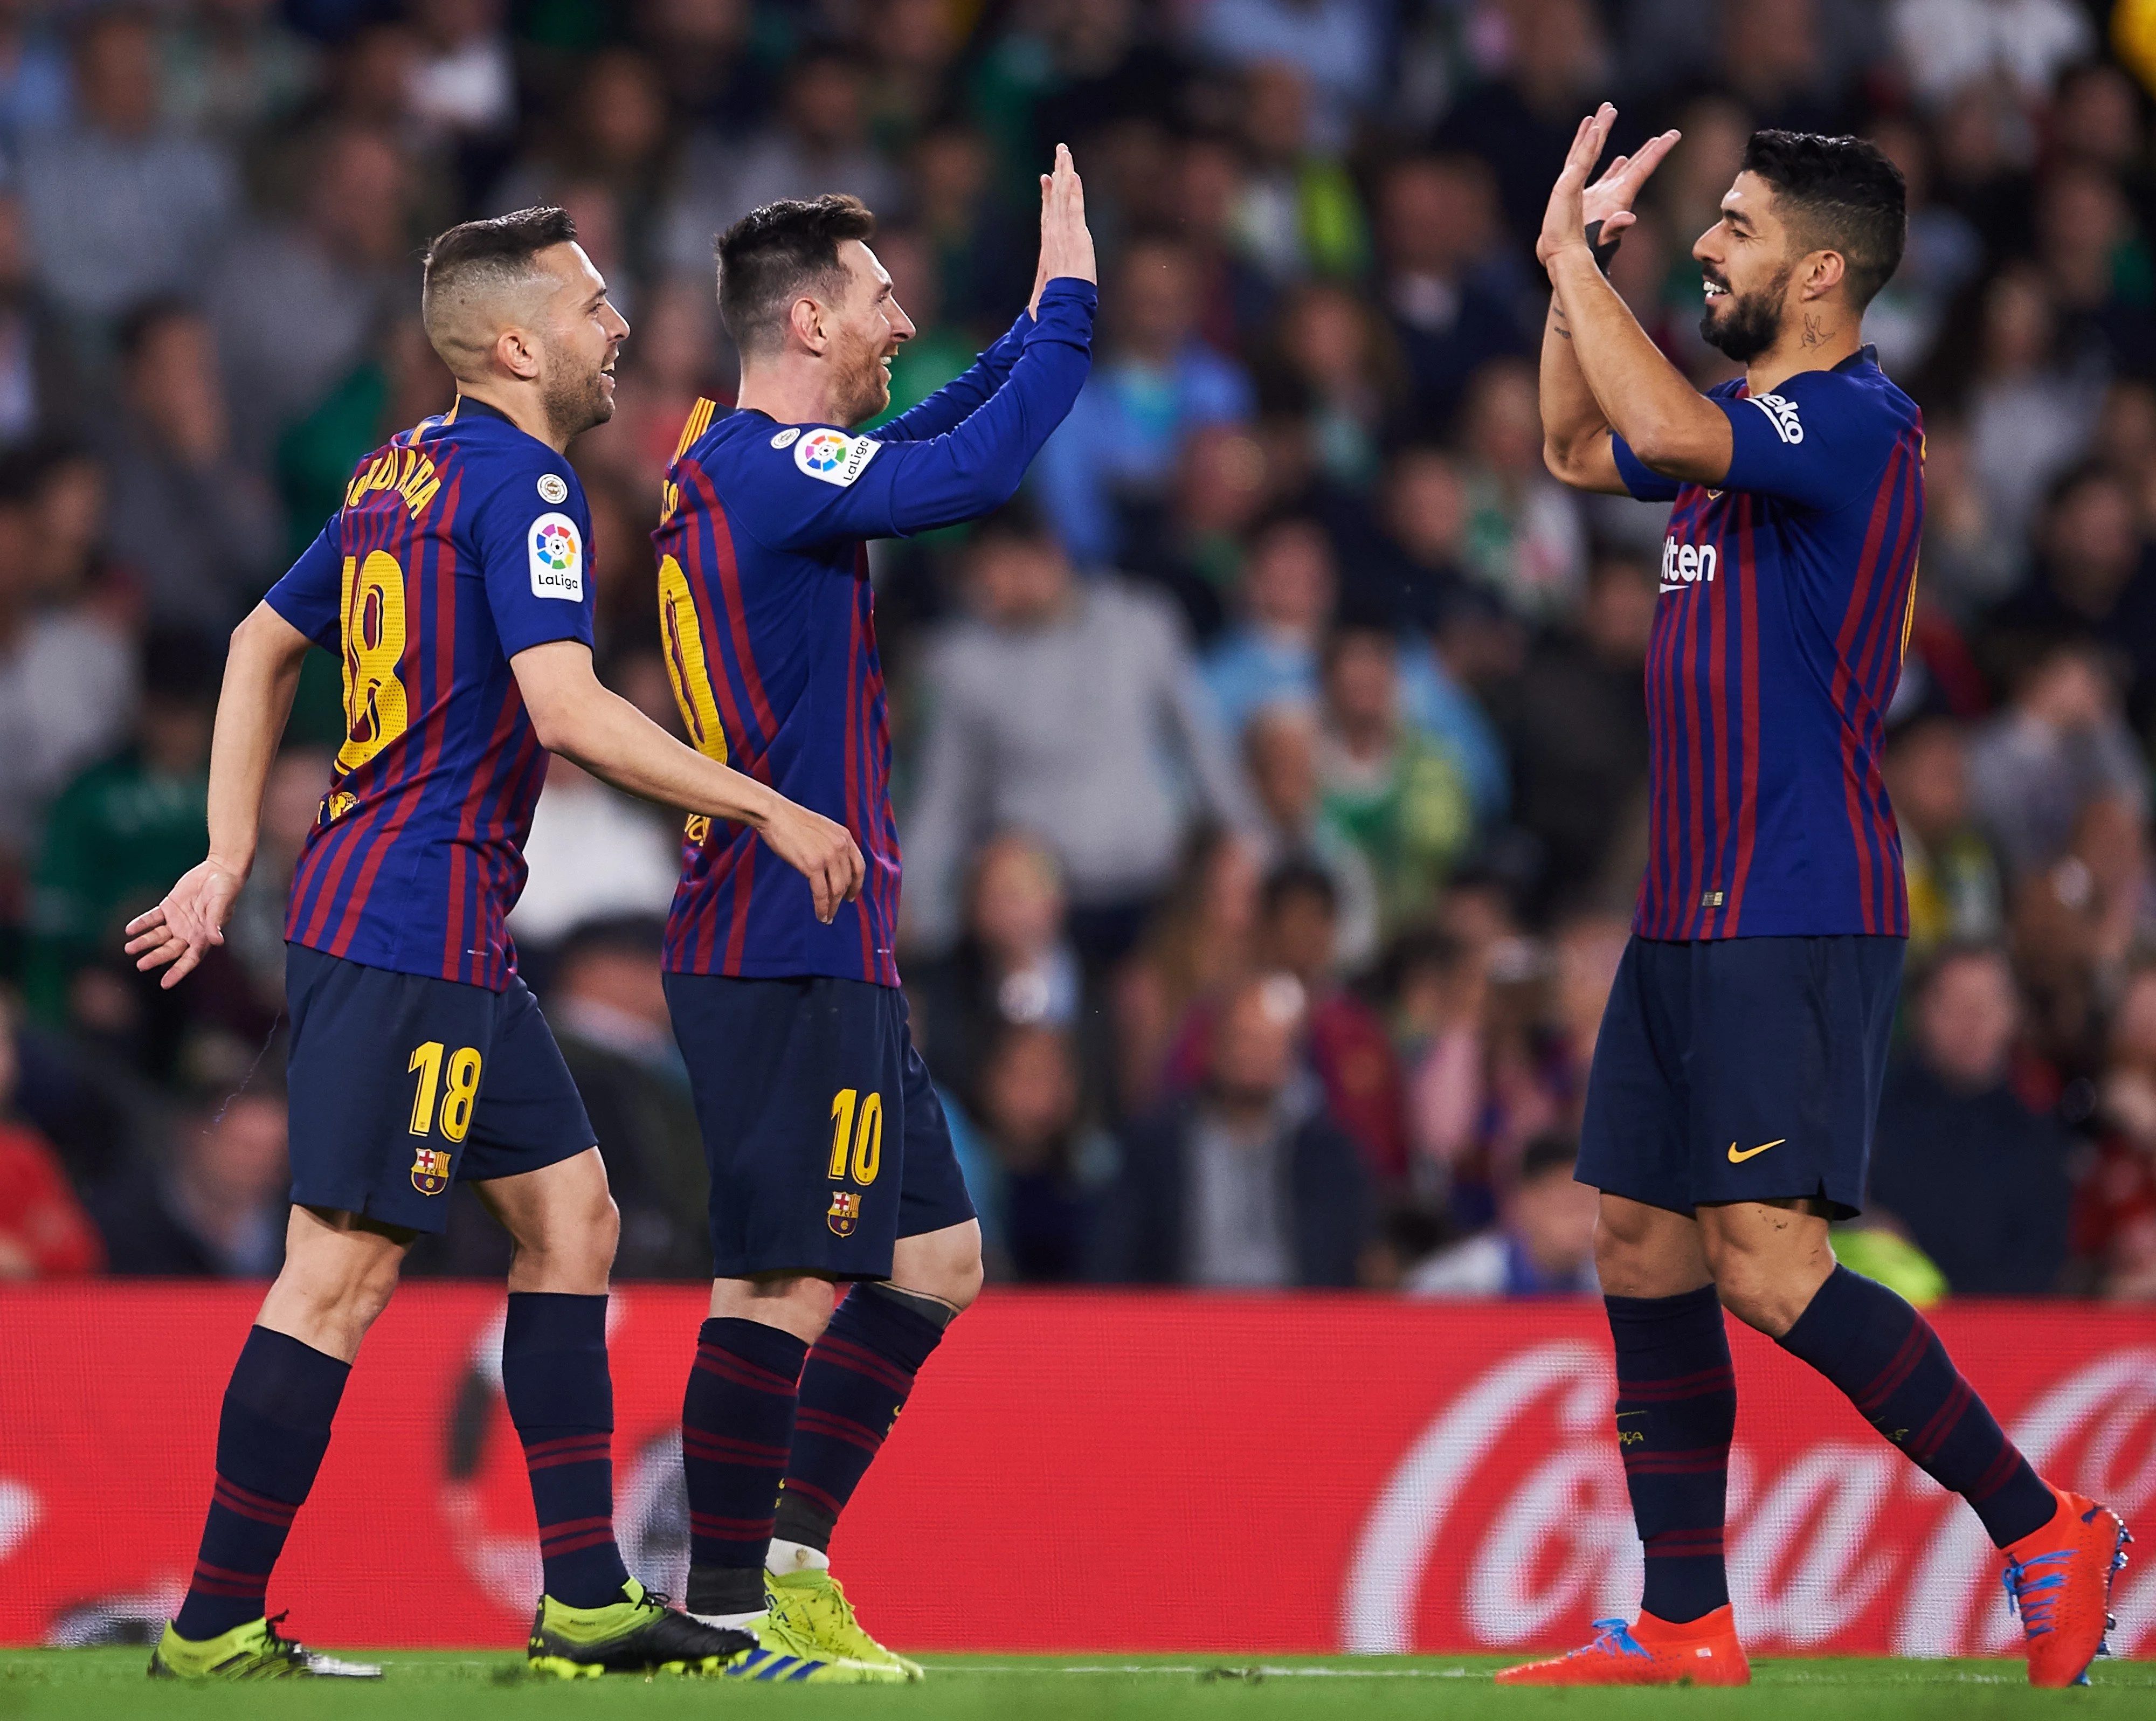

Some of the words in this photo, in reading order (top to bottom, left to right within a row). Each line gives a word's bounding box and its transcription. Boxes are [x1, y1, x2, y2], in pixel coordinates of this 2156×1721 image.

[1751, 393, 1804, 444] eko
[843, 440, 869, 481] LaLiga
[538, 573, 578, 590] LaLiga
[334, 550, 408, 776] 18
[408, 1041, 482, 1143] 18
[828, 1088, 882, 1186] 10
